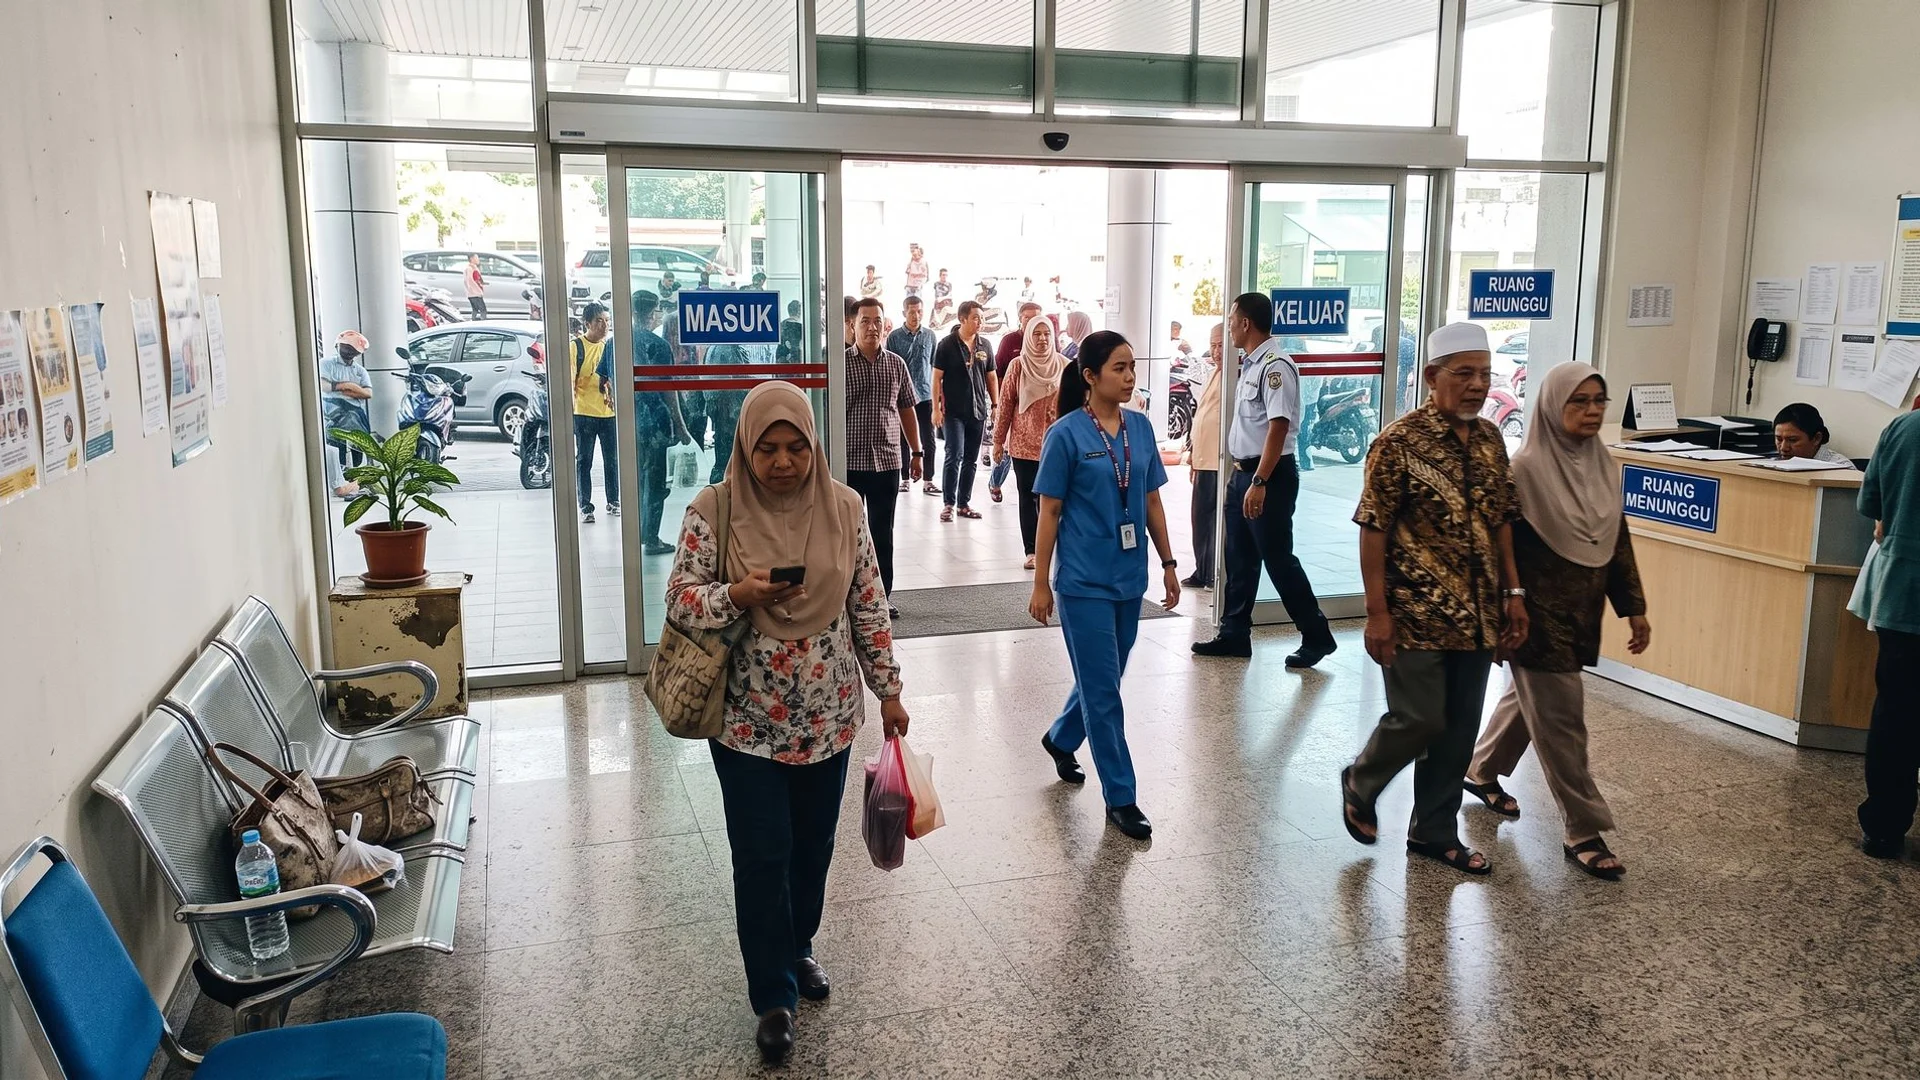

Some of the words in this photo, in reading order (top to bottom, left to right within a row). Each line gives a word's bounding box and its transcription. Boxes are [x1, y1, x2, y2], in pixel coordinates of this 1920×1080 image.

[1488, 276, 1535, 292] RUANG
[1273, 300, 1345, 325] KELUAR
[1472, 296, 1549, 313] MENUNGGU
[684, 303, 774, 333] MASUK
[1642, 475, 1695, 499] RUANG
[1625, 492, 1711, 522] MENUNGGU
